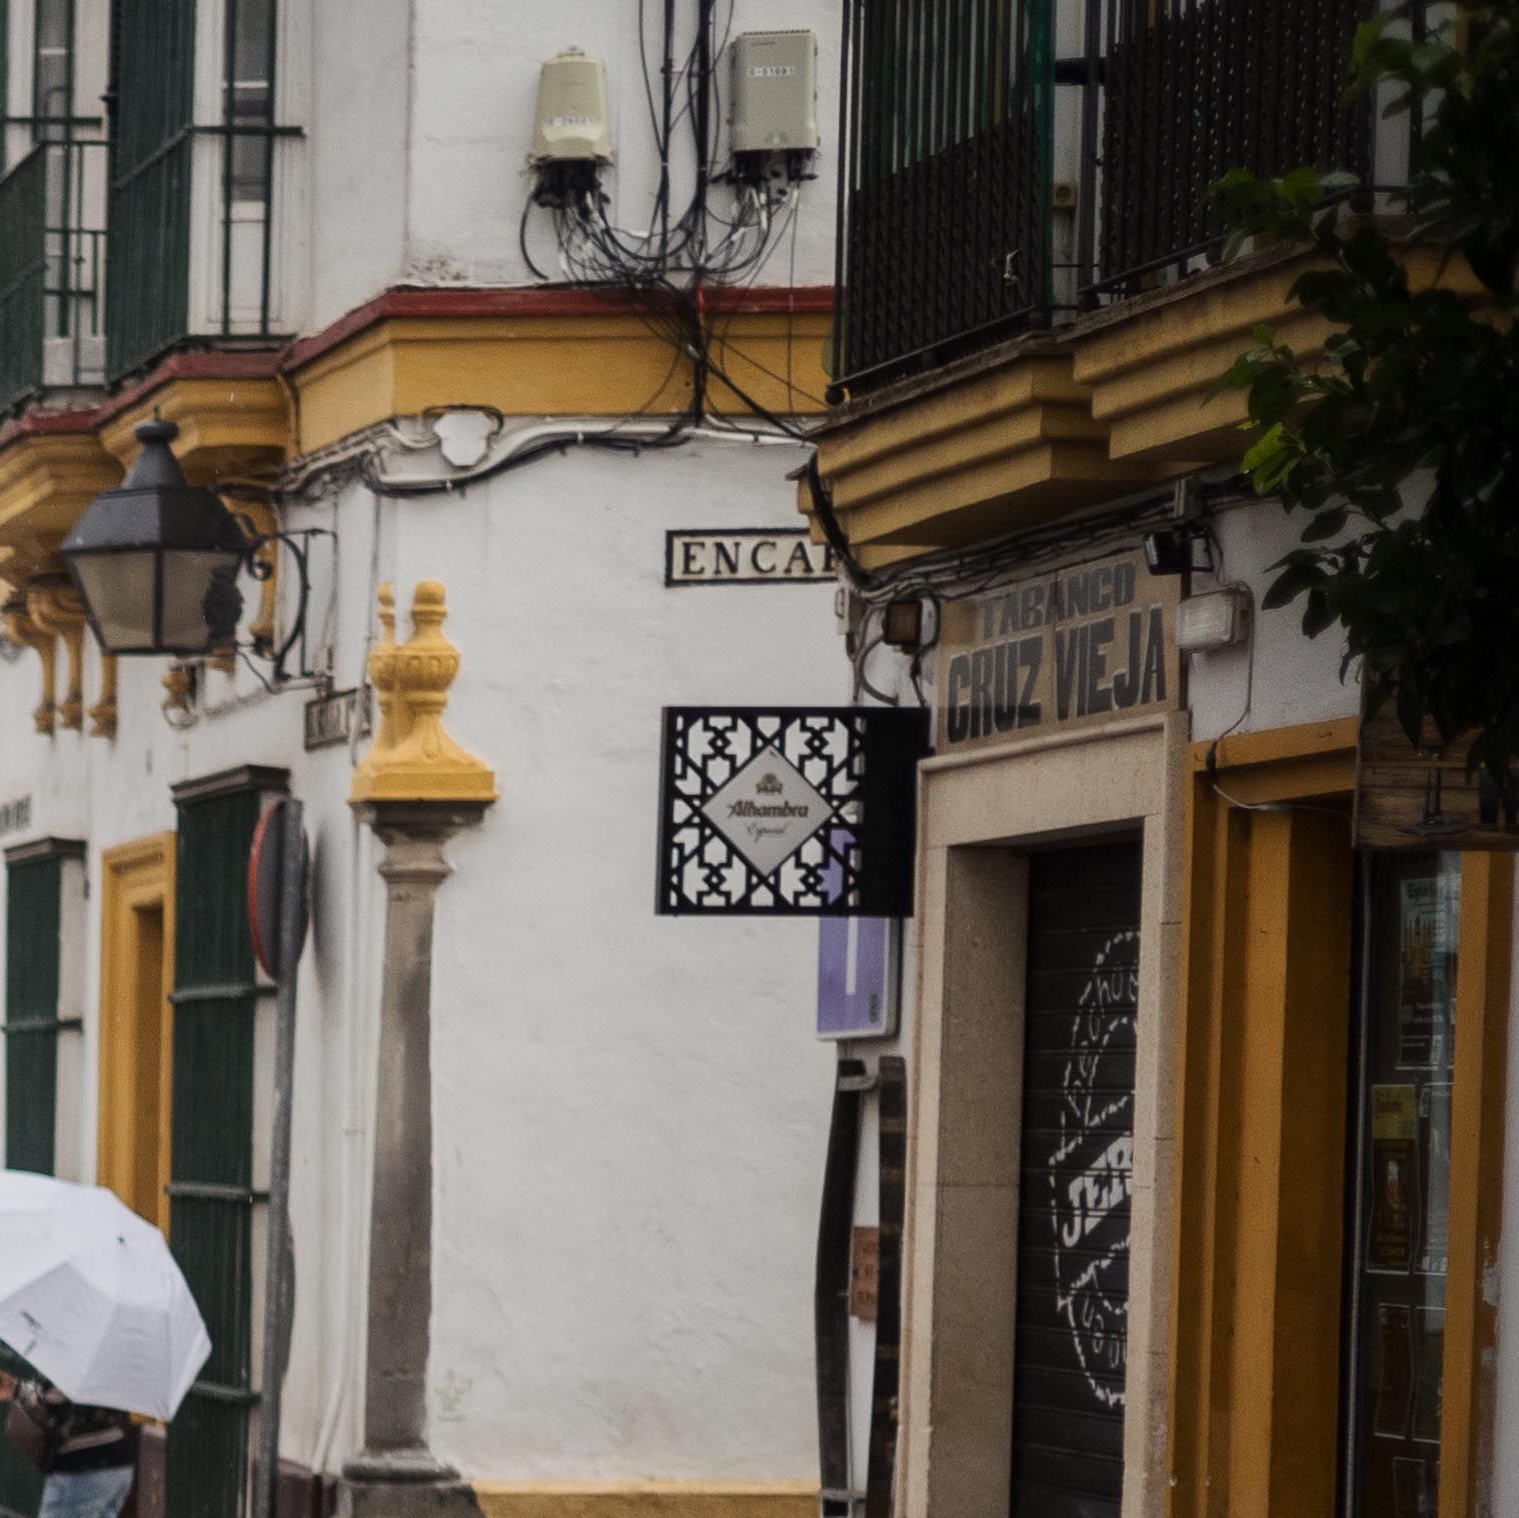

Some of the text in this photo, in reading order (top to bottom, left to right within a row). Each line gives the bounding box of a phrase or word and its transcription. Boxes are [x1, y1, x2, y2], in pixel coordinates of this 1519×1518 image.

[979, 560, 1136, 641] TABANCO
[946, 602, 1167, 743] CRUZ VIEJA
[728, 800, 809, 818] Alhambra
